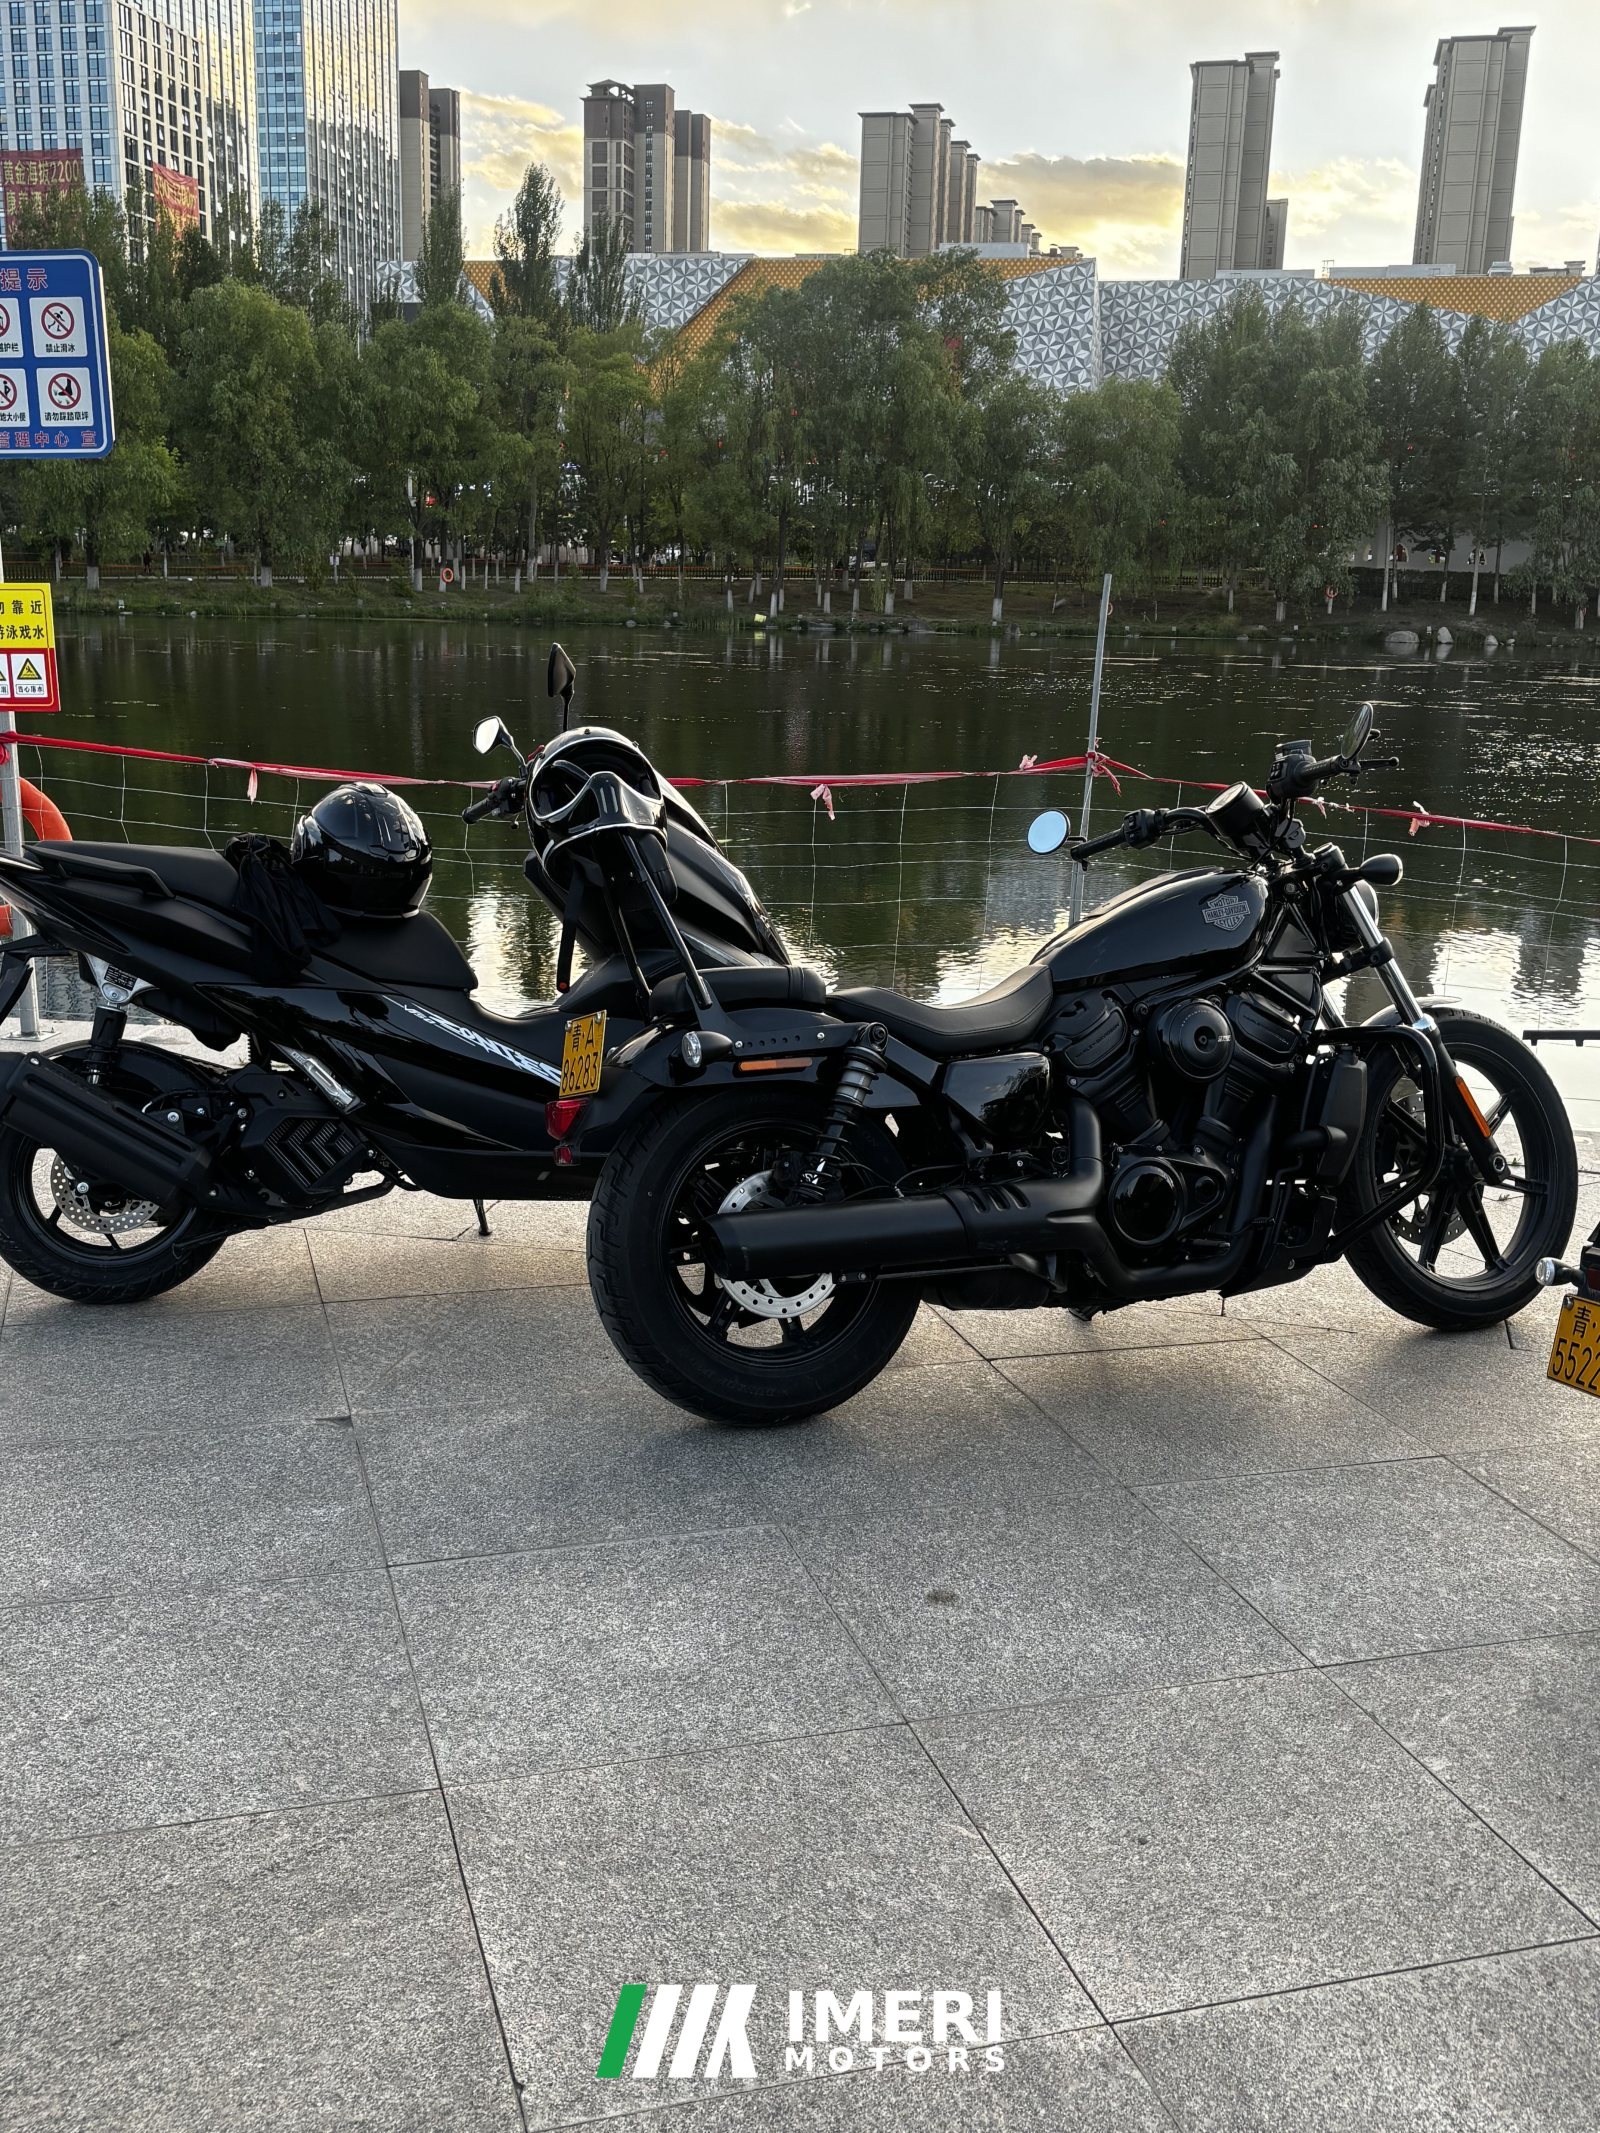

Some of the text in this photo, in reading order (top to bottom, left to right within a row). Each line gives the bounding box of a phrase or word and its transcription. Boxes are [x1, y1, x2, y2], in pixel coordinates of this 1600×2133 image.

[0, 268, 48, 291] 提示
[45, 343, 76, 353] 禁止滑冰
[44, 411, 89, 422] 请勿踩踏草坪
[81, 430, 97, 447] 宣
[561, 1051, 599, 1093] 86283
